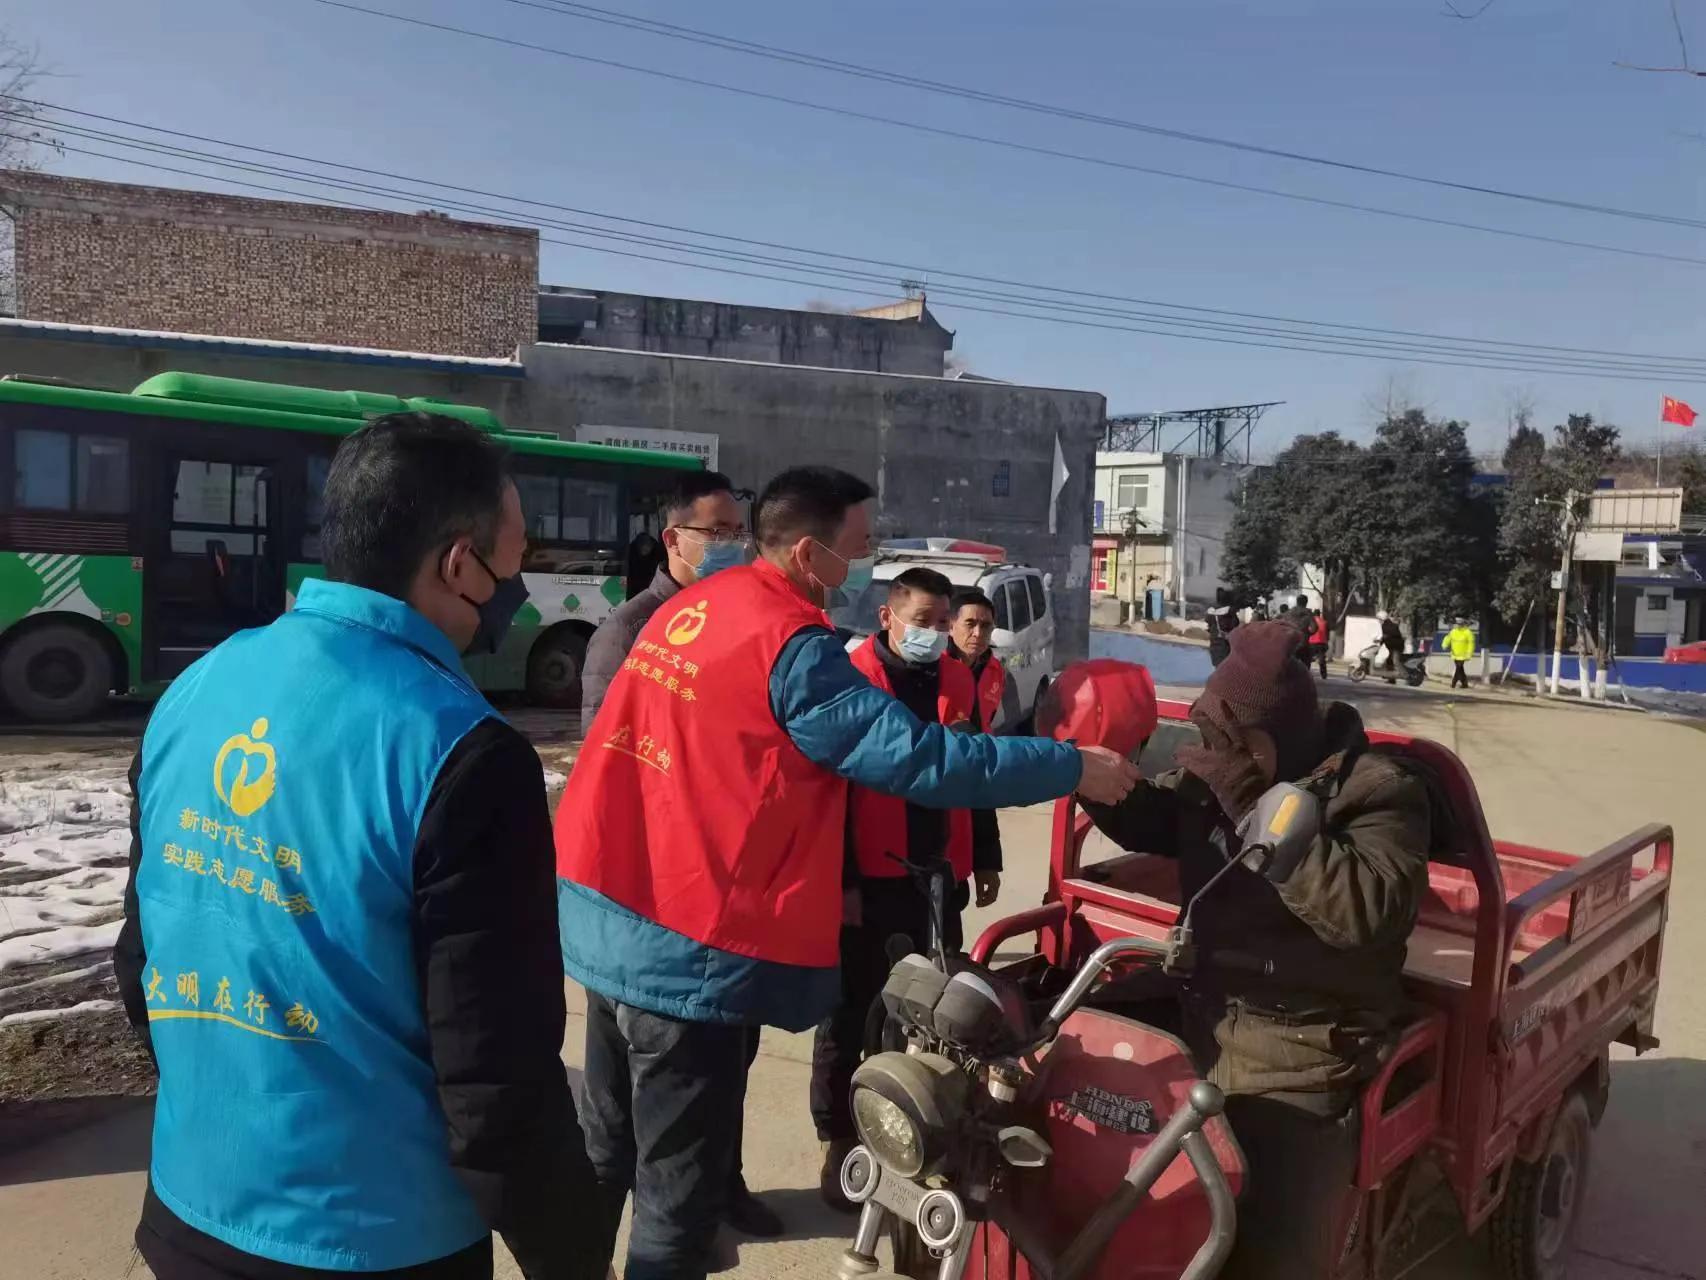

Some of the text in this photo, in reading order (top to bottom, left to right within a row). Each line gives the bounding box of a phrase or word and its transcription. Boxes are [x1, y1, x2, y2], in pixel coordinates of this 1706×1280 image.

[179, 807, 302, 875] 新时代文明
[163, 842, 317, 915] 实践志愿服务
